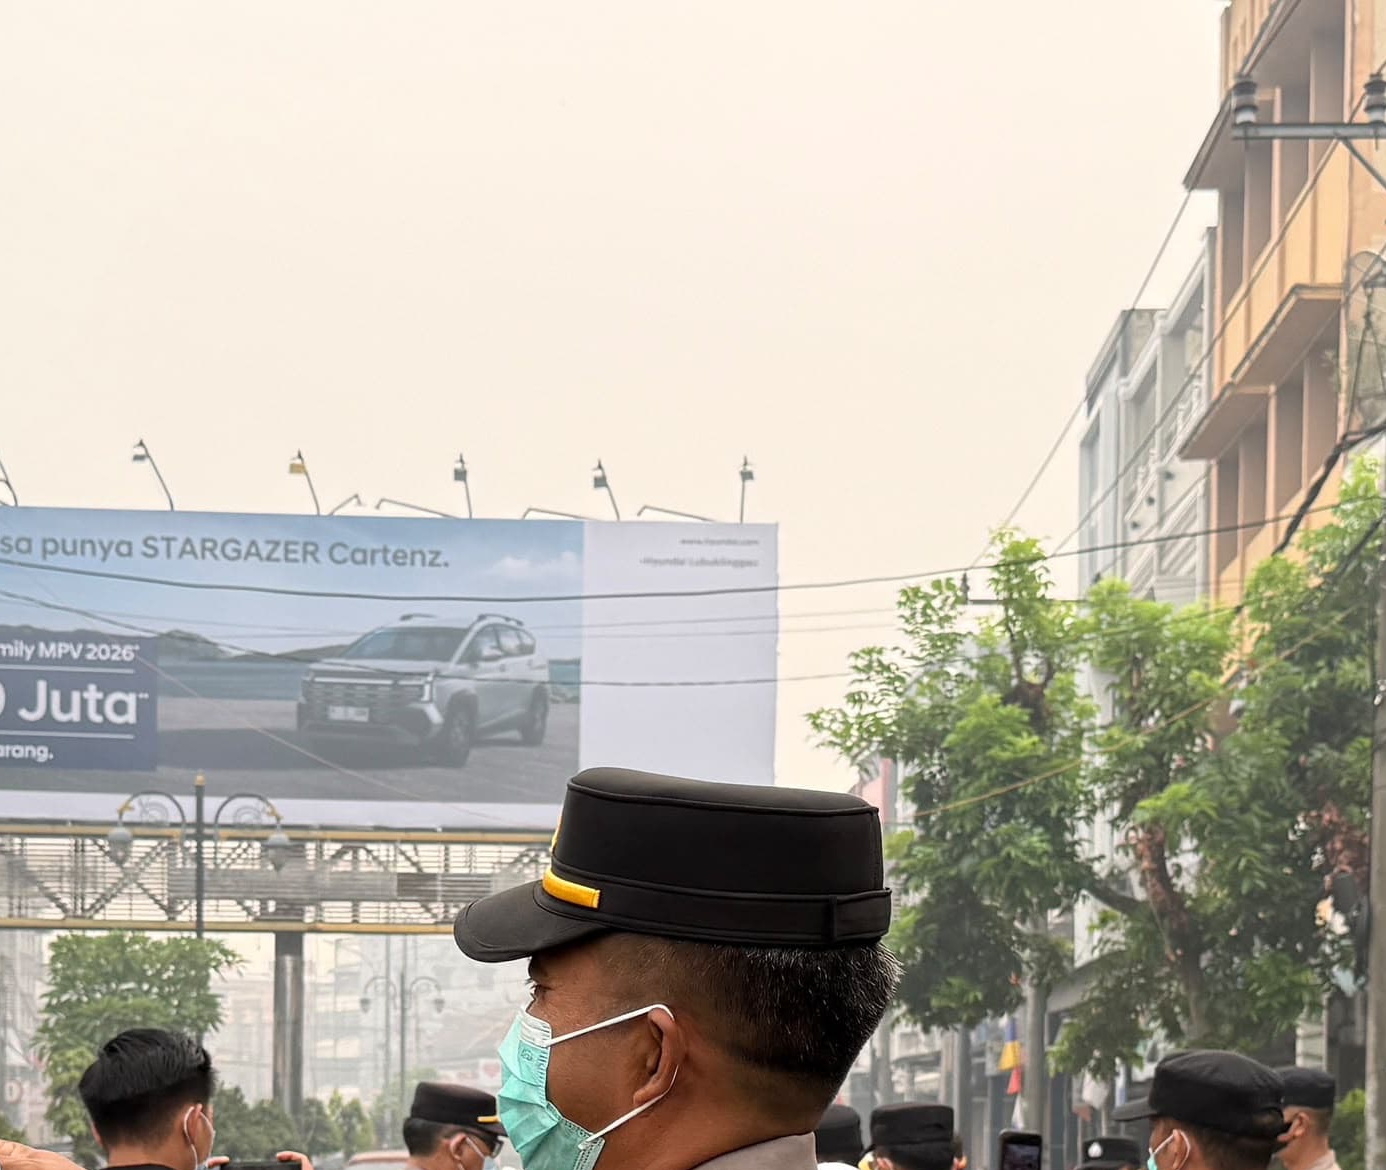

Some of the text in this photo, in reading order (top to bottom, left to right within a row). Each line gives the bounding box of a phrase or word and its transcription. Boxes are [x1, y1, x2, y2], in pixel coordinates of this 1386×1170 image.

[42, 534, 133, 562] punya
[141, 536, 319, 564] STARGAZER
[329, 542, 450, 568] Cartenz.
[39, 641, 82, 661] MPV
